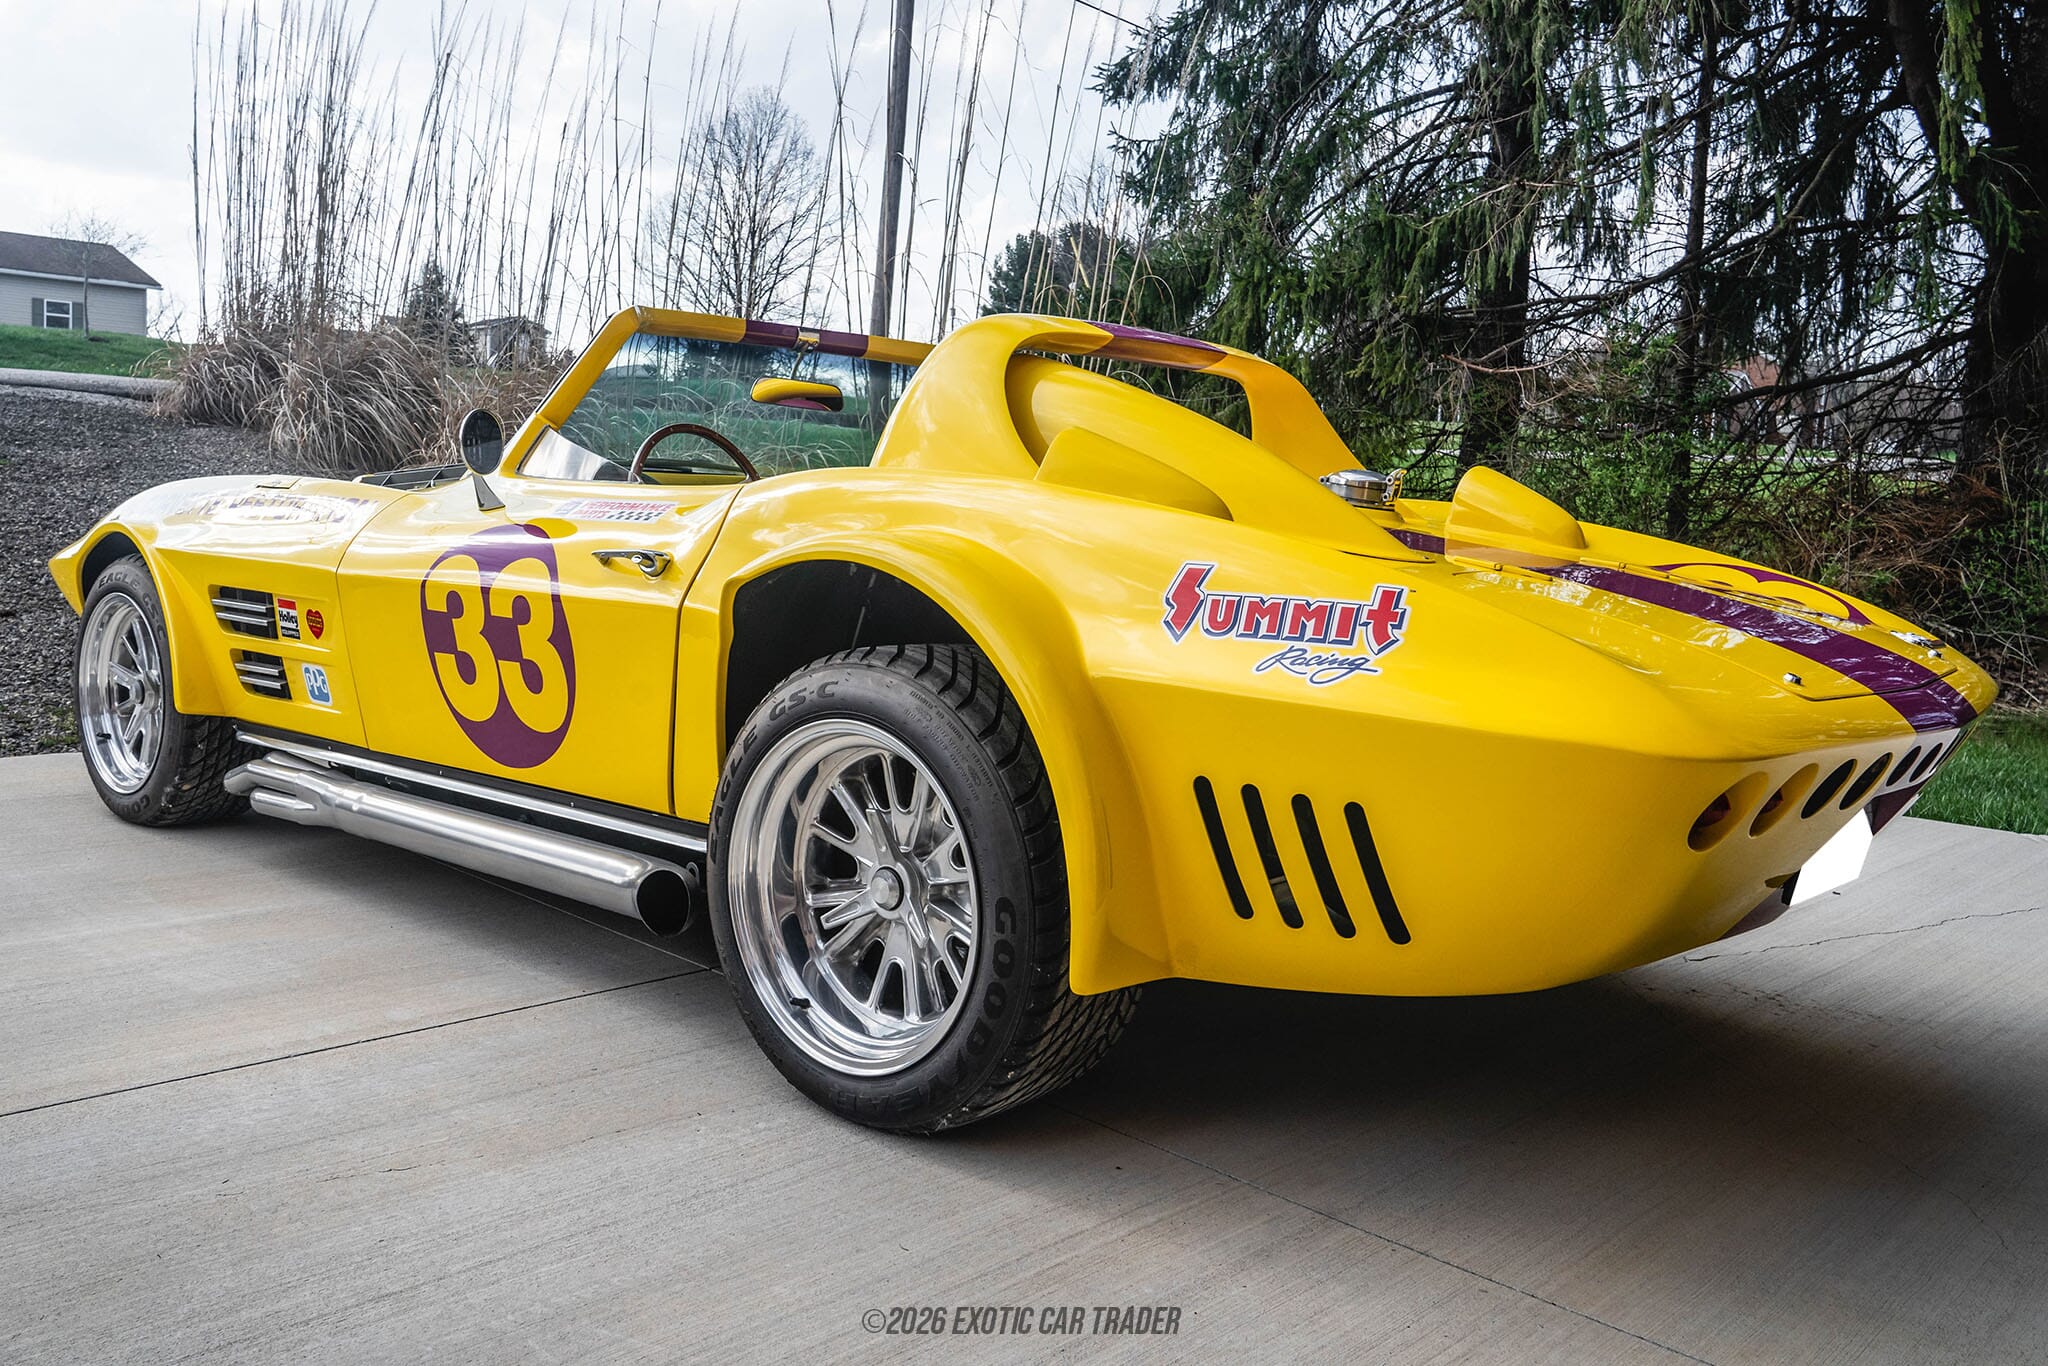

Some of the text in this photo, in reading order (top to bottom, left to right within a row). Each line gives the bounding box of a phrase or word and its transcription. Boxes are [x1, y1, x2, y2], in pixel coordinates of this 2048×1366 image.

[582, 501, 677, 512] PERFORMANCE
[98, 571, 140, 591] EAGLE
[278, 610, 299, 629] Holley
[425, 554, 569, 733] 33
[1255, 645, 1378, 684] Racing
[306, 669, 328, 696] PPG
[710, 725, 757, 865] EAGLE
